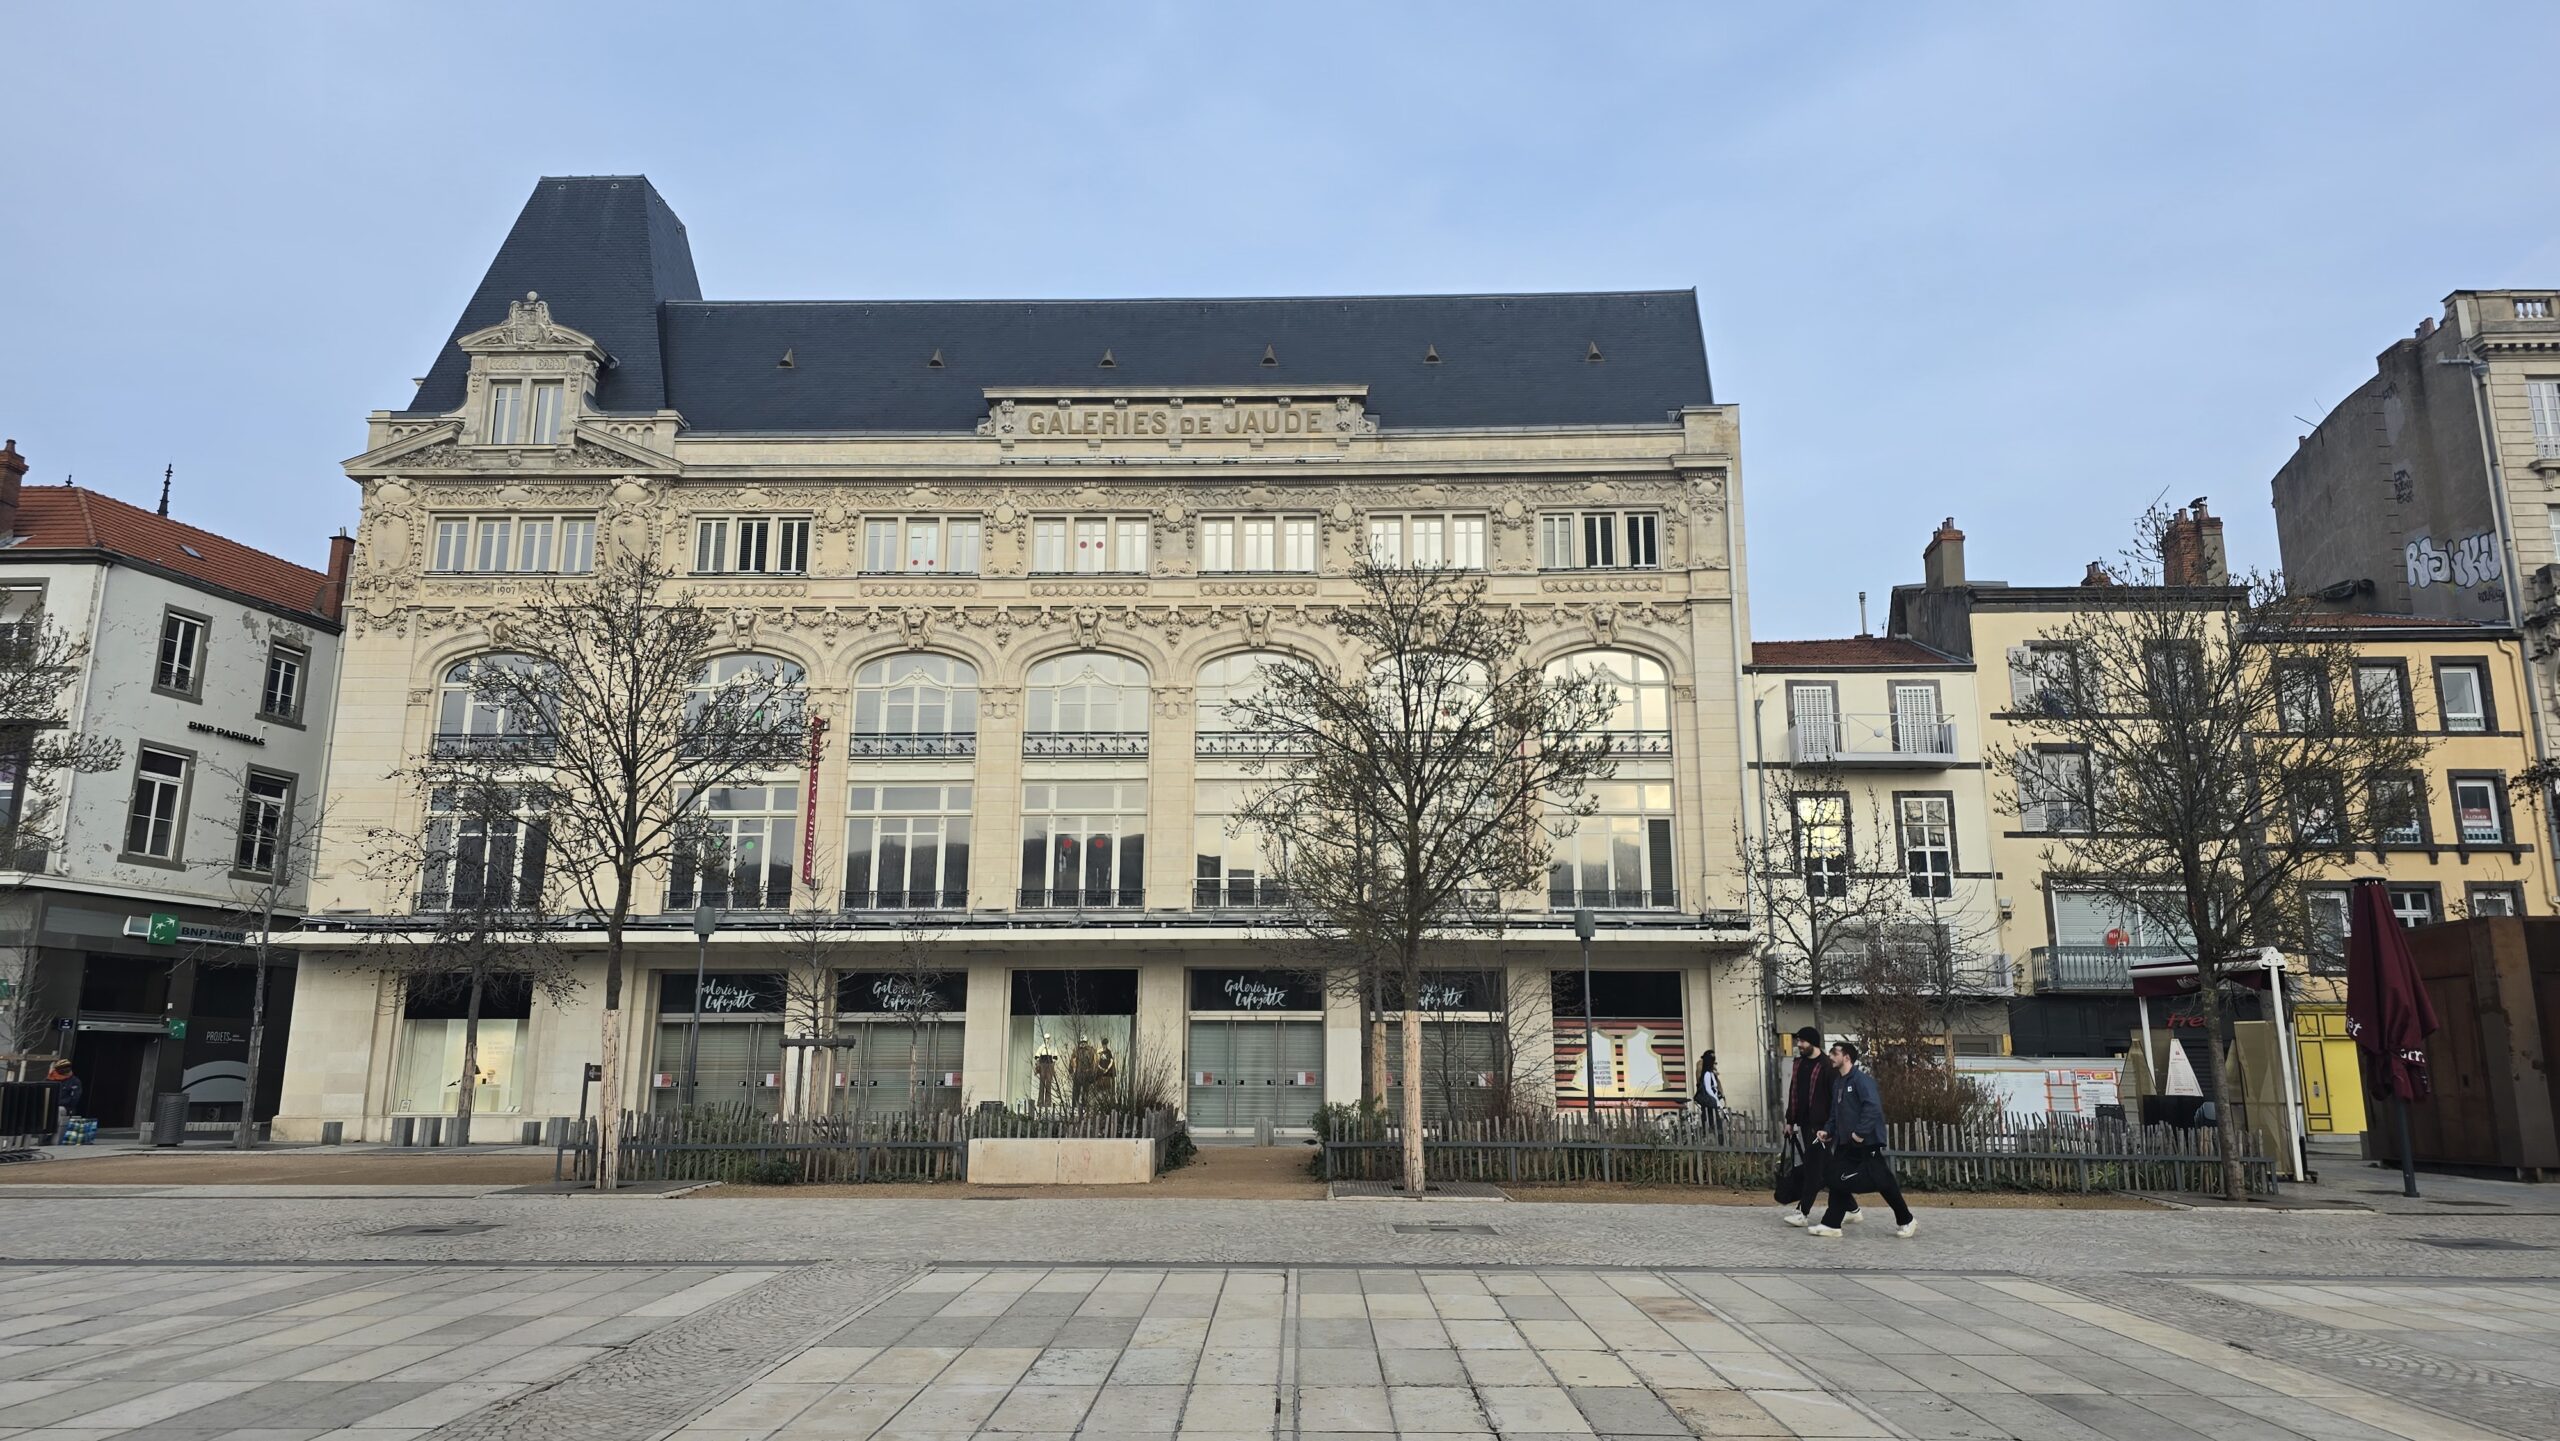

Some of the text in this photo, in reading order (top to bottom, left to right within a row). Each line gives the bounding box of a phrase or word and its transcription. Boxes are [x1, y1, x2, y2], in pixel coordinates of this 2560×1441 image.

[1027, 410, 1323, 435] GALERIES DE JAUDE
[497, 586, 516, 596] 1907
[187, 721, 266, 746] BNP PARIBAS
[805, 808, 815, 880] GALERIES
[181, 927, 207, 937] BNP
[1224, 975, 1267, 997] Galeries
[705, 989, 759, 1013] Lafayette
[1235, 987, 1288, 1010] Lafayette
